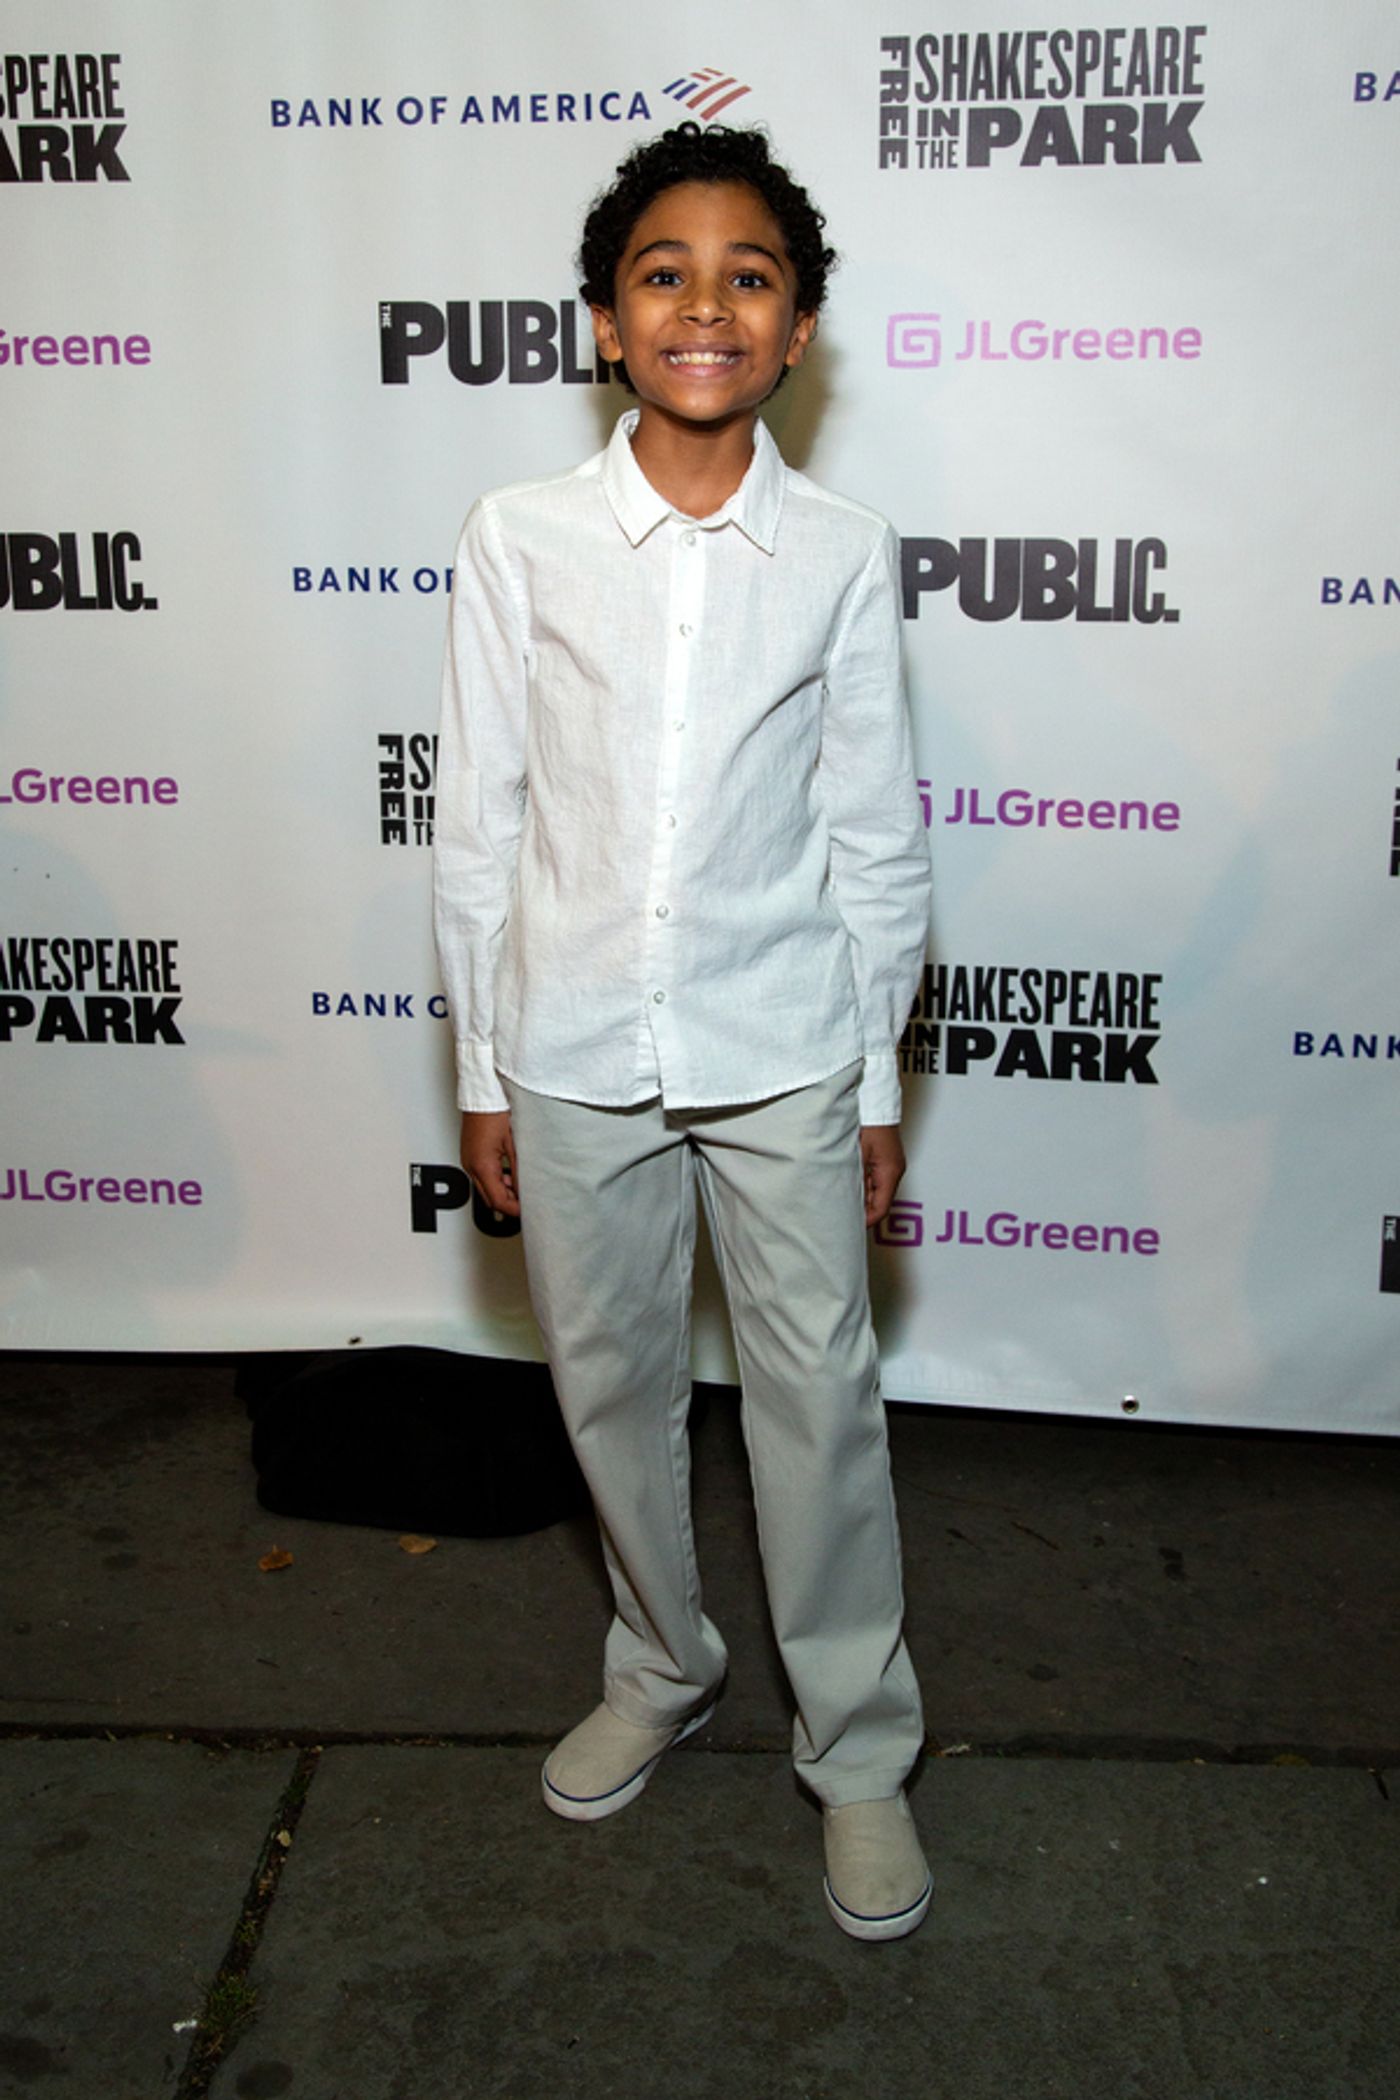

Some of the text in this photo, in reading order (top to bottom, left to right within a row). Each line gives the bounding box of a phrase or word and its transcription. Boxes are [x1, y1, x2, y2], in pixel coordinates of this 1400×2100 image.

[0, 54, 124, 119] PEARE
[915, 26, 1206, 101] SHAKESPEARE
[271, 91, 650, 127] BANK OF AMERICA
[880, 36, 910, 169] FREE
[916, 108, 960, 138] IN
[916, 140, 958, 168] THE
[965, 101, 1204, 167] PARK
[379, 300, 610, 386] PUBL
[955, 319, 1202, 361] JLGreene
[0, 530, 159, 612] BLIC.
[294, 568, 399, 593] BANK
[899, 537, 1180, 624] PUBLIC.
[378, 734, 407, 845] FREE
[945, 788, 1180, 832] JLGreene
[0, 995, 185, 1045] PARK
[313, 992, 414, 1018] BANK
[908, 963, 1163, 1030] HAKESPEARE
[900, 1049, 939, 1075] THE
[946, 1026, 1161, 1085] PARK
[936, 1210, 1160, 1256] JLGreene
